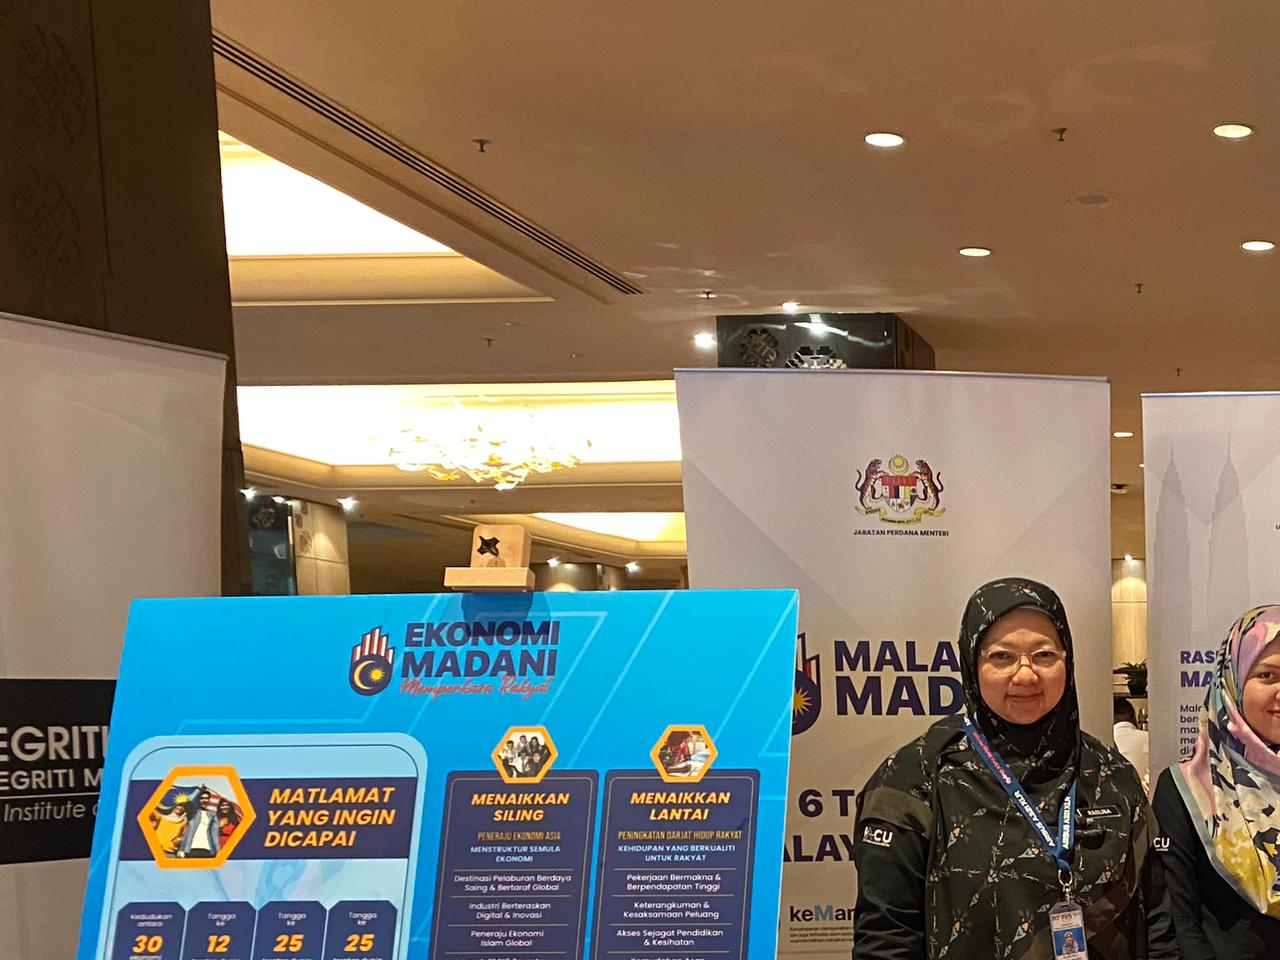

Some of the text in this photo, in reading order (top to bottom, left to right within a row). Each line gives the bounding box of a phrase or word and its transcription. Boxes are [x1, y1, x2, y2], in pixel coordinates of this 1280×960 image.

[405, 621, 560, 647] EKONOMI
[401, 649, 558, 677] MADANI
[1180, 651, 1218, 664] RAS
[270, 787, 395, 805] MATLAMAT
[471, 792, 570, 806] MENAIKKAN
[630, 792, 731, 804] MENAIKKAN
[798, 789, 824, 818] 6
[4, 801, 86, 822] Institute
[267, 808, 396, 826] YANG INGIN
[493, 809, 544, 822] SILING
[649, 808, 710, 820] LANTAI
[264, 830, 356, 847] DICAPAI
[618, 830, 742, 840] PENINGKATAN DARJAT HIDUP RAKYAT
[618, 844, 736, 852] KEHIDUPAN YANG BERKUALITI
[645, 854, 706, 862] UNTUK RAKYAT
[454, 874, 572, 884] Destinasi Pelaburan Berdaya
[627, 873, 722, 883] Pekerjaan Bermakna &
[464, 884, 560, 893] Saing & Bertaraf Global
[627, 882, 720, 892] Berpendapatan Tinggi
[469, 902, 552, 910] Industri Berteraskan
[634, 901, 710, 910] Keterangkuman &
[476, 912, 542, 920] Digital & Inovasi
[623, 910, 720, 920] Kesaksamaan Peluang
[470, 930, 544, 939] Peneraju Ekonomi
[616, 929, 724, 938] Akses Sejagat Pendidikan
[132, 935, 164, 954] 30
[207, 934, 231, 953] 12
[272, 934, 304, 952] 25
[344, 934, 375, 952] 25
[480, 939, 532, 948] Islam Global
[644, 938, 694, 947] & Kesihatan
